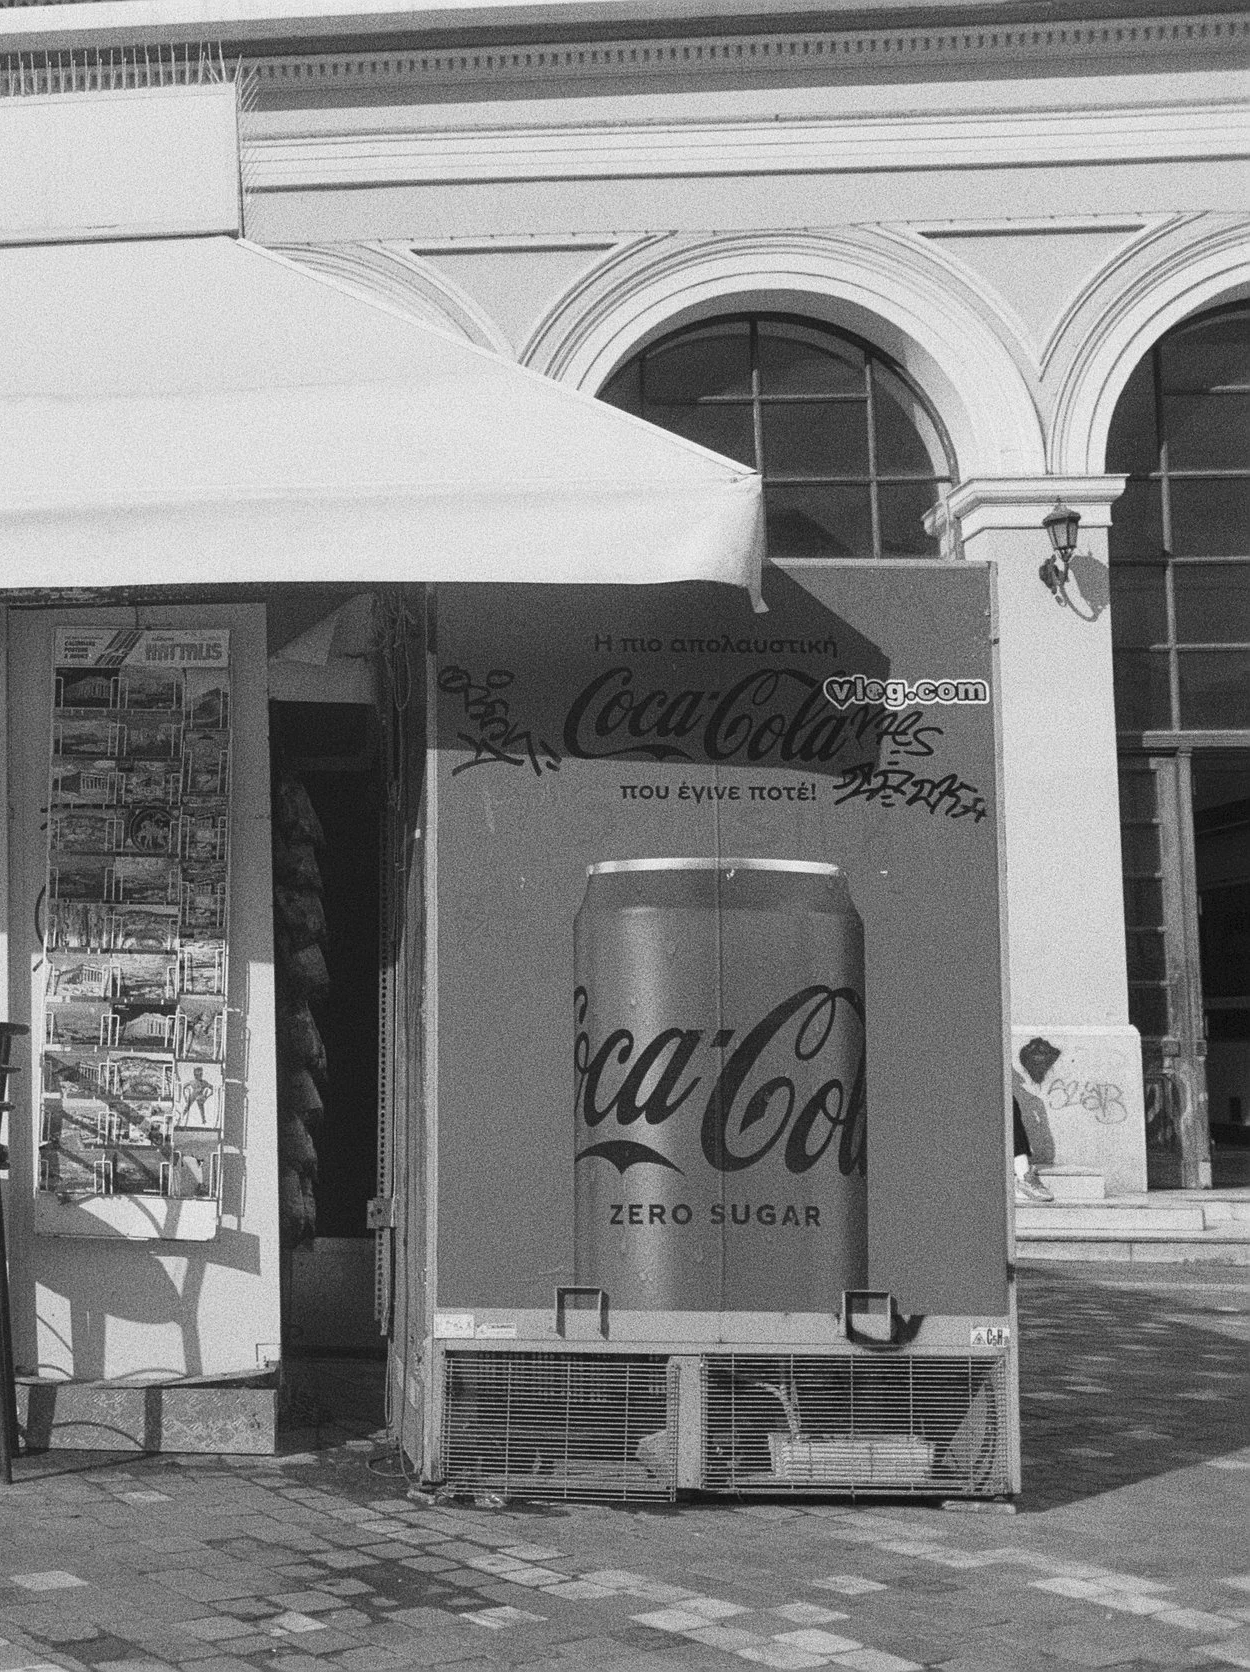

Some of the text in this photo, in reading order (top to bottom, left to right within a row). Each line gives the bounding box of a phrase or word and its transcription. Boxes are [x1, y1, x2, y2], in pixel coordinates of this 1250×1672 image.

[621, 637, 662, 653] πιο
[670, 634, 838, 659] απολαυστική
[619, 780, 818, 802] που έγινε ποτέ!
[610, 1204, 821, 1226] ZERO SUGAR
